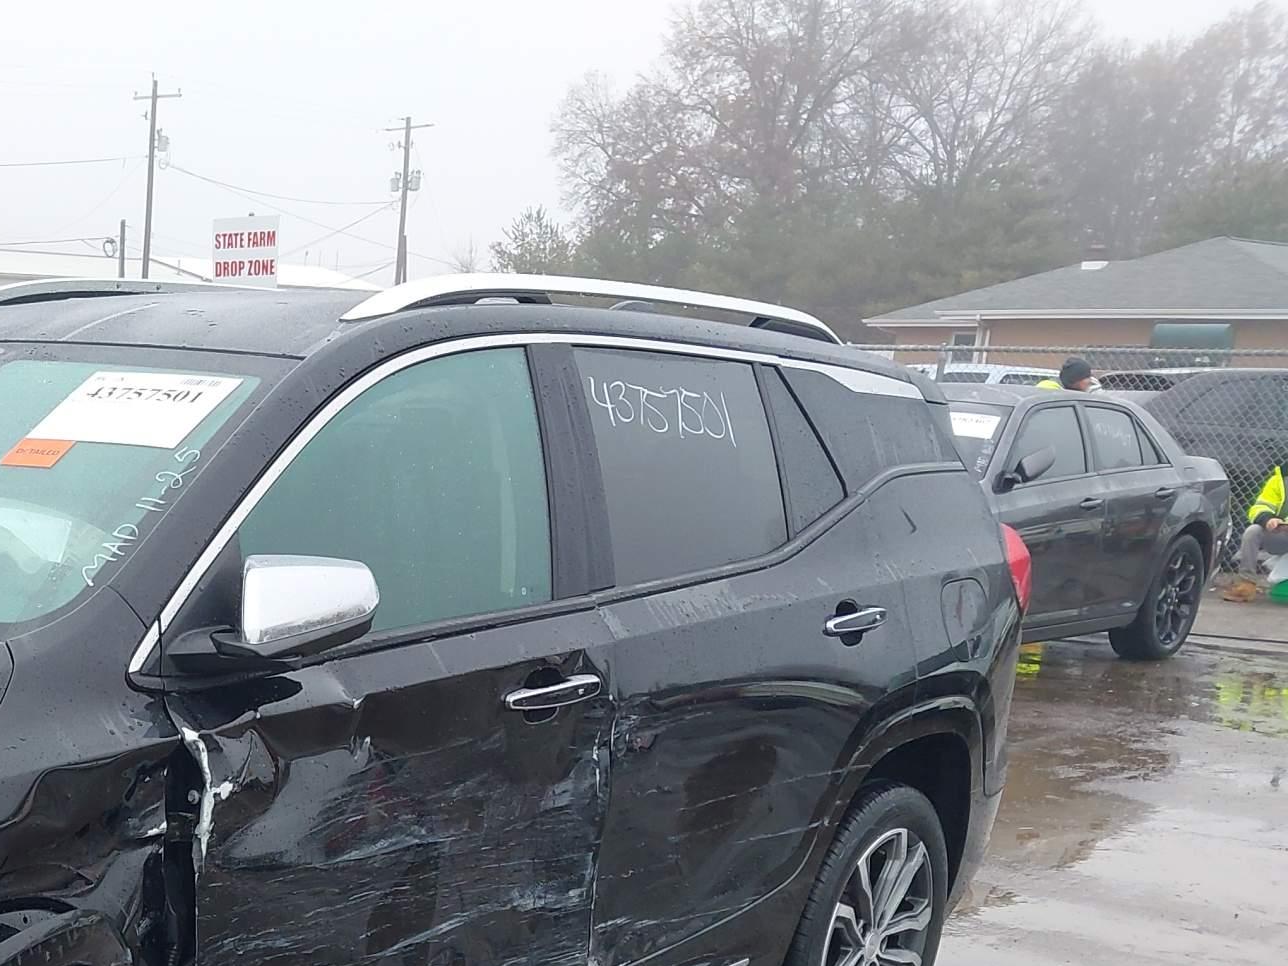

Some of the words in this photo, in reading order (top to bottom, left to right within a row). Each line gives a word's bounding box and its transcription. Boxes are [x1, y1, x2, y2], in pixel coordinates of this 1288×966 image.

[215, 232, 245, 249] STATE
[247, 230, 276, 248] FARM
[215, 261, 245, 278] DROP
[247, 259, 275, 276] ZONE
[86, 386, 204, 403] 43757501
[587, 376, 737, 448] 43757501
